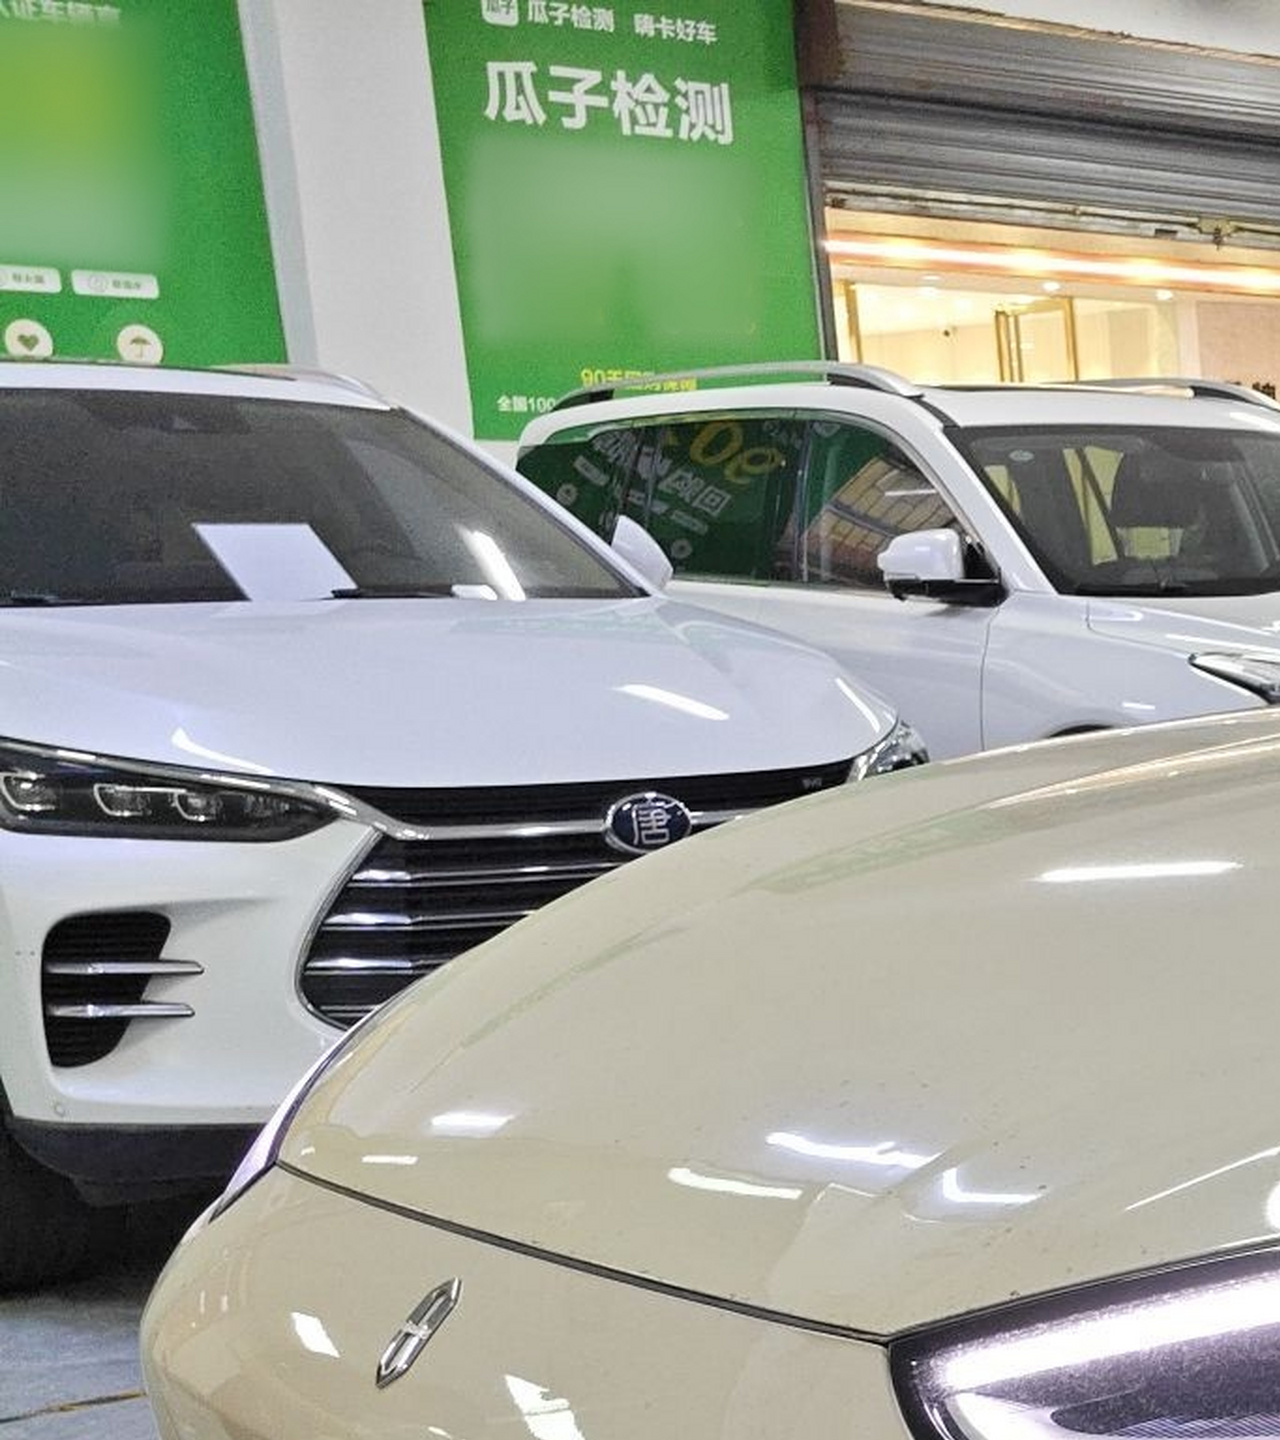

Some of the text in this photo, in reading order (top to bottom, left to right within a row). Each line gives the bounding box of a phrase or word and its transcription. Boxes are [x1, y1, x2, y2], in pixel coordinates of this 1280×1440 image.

[528, 0, 615, 33] 瓜子检测
[483, 60, 734, 146] 瓜子检测
